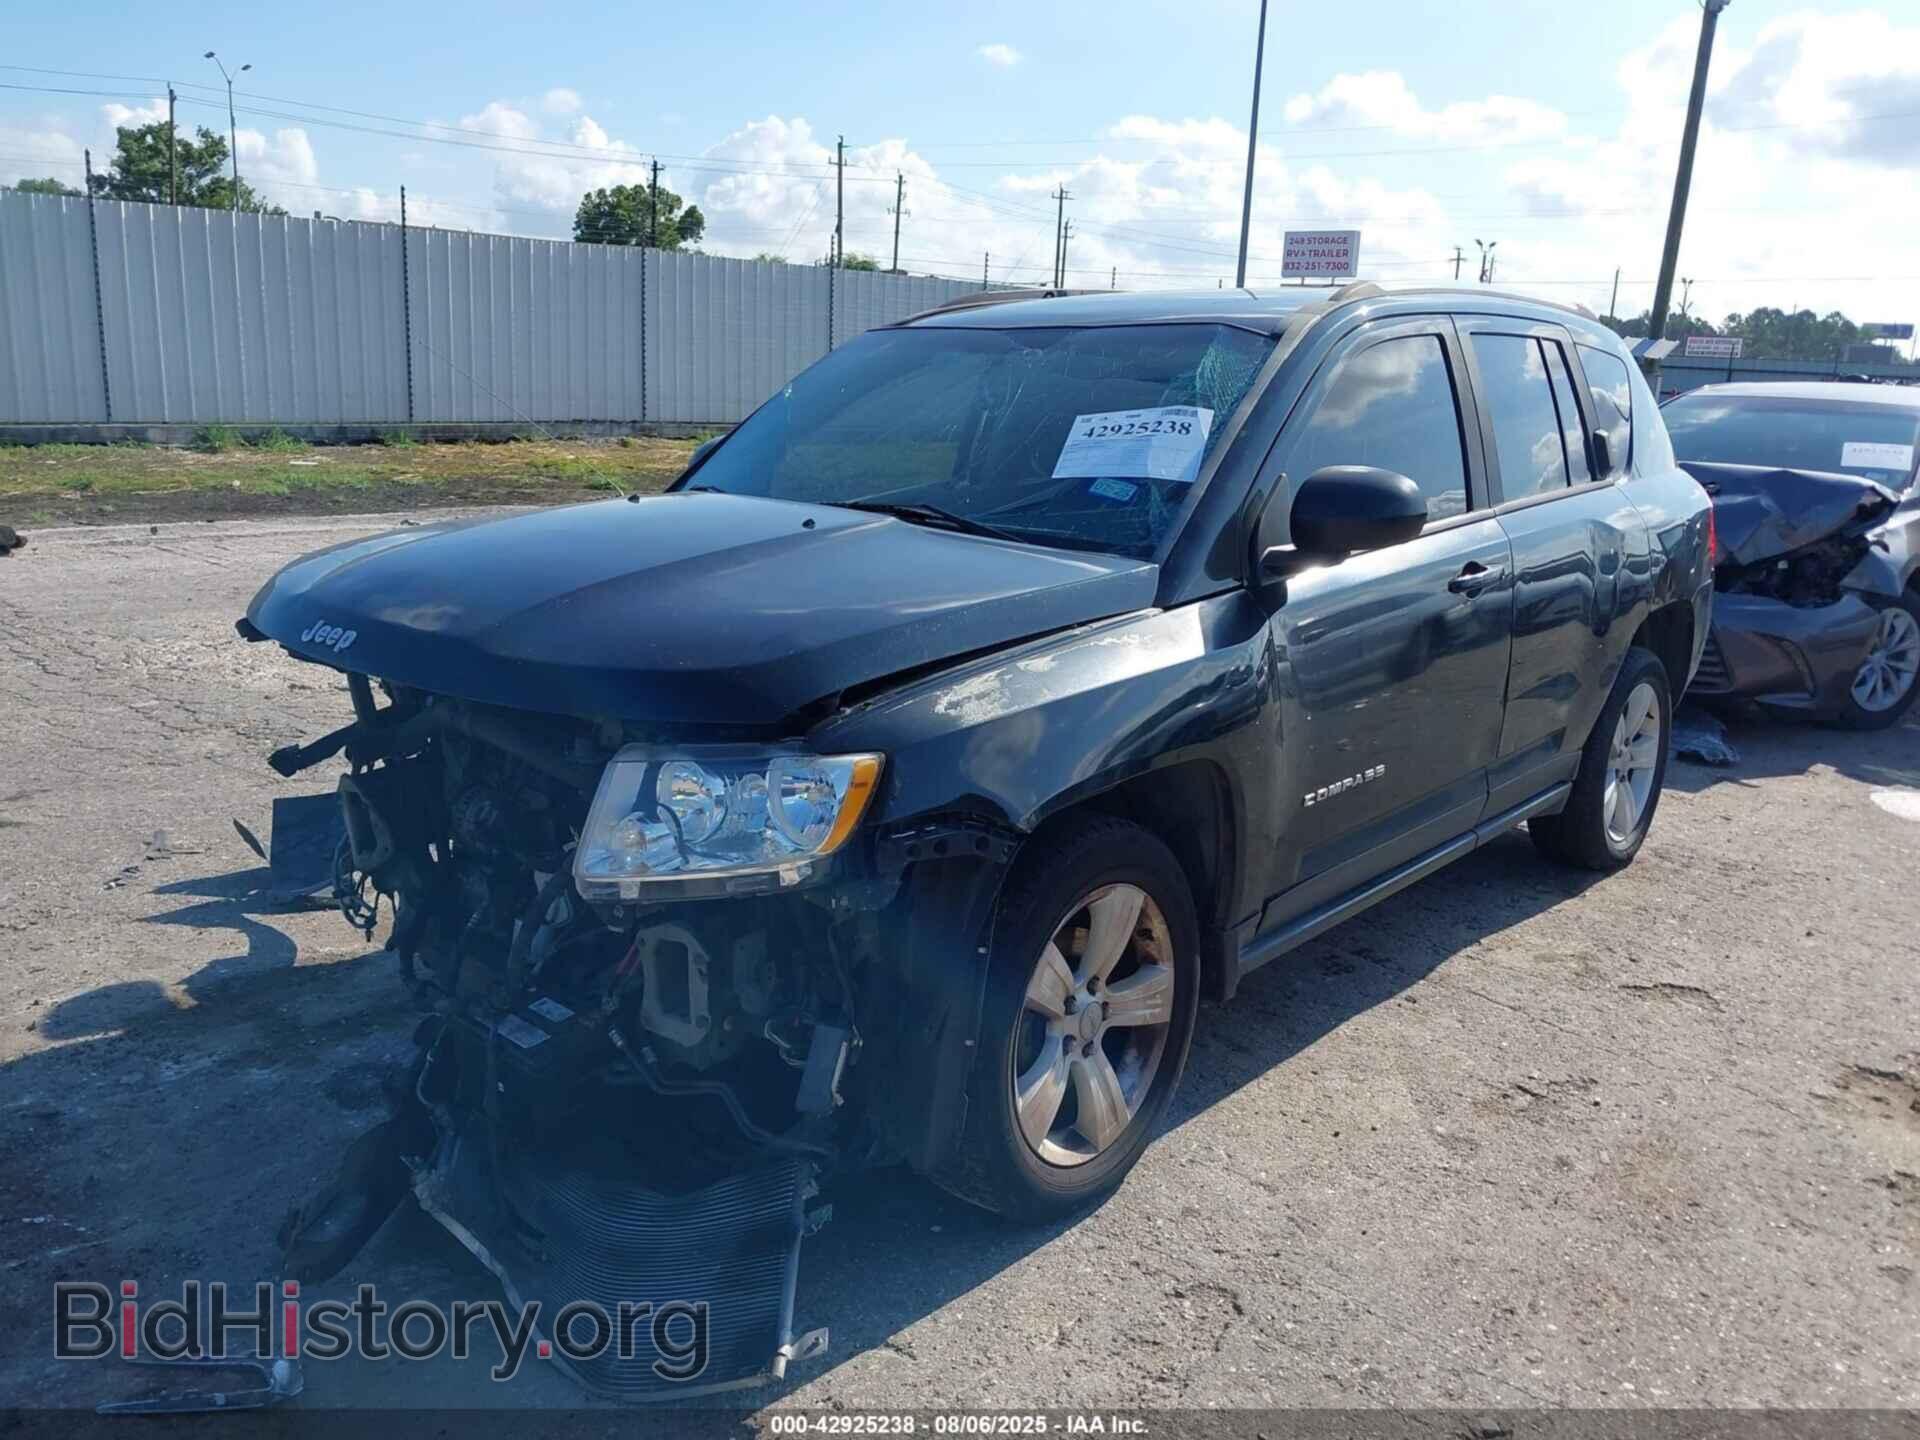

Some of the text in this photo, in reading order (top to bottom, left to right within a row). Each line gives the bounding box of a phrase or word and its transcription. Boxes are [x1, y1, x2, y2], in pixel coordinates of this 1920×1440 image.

[1307, 236, 1348, 245] STORAGE
[1286, 249, 1300, 257] RV
[1308, 248, 1349, 257] TRAILER
[1283, 261, 1350, 271] 832-251-7300
[1081, 420, 1192, 438] 42925238
[301, 619, 358, 653] Jeep
[1303, 763, 1386, 807] COMPASS
